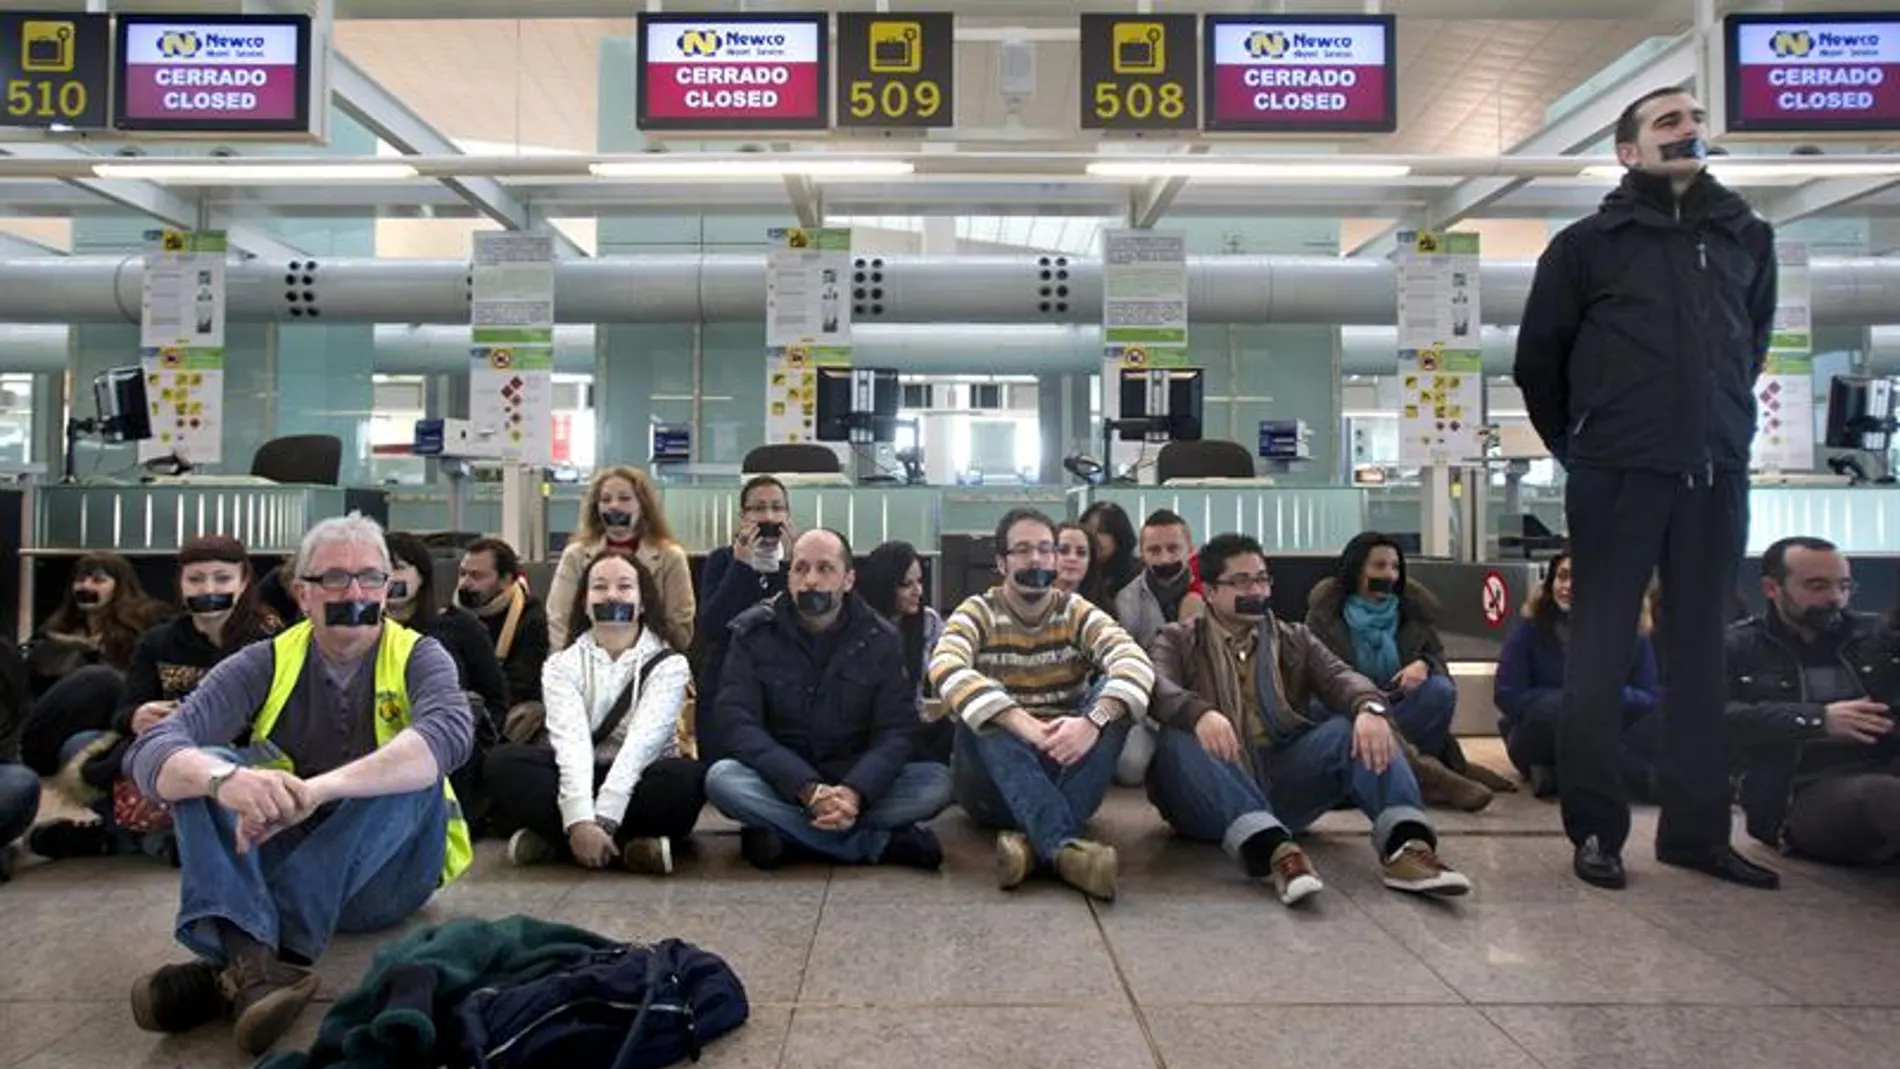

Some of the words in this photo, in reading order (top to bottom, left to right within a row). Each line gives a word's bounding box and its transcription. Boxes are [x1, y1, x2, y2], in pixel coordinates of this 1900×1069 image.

[206, 34, 265, 48] Newco
[726, 31, 785, 46] Newco
[1293, 33, 1352, 48] Newco
[1819, 32, 1880, 46] Newco
[155, 69, 267, 86] CERRADO
[675, 67, 789, 85] CERRADO
[1244, 69, 1356, 87] CERRADO
[1768, 68, 1884, 86] CERRADO
[7, 80, 87, 116] 510
[163, 92, 256, 109] CLOSED
[684, 90, 778, 108] CLOSED
[850, 81, 941, 117] 509
[1095, 82, 1184, 118] 508
[1254, 92, 1347, 110] CLOSED
[1778, 92, 1873, 110] CLOSED
